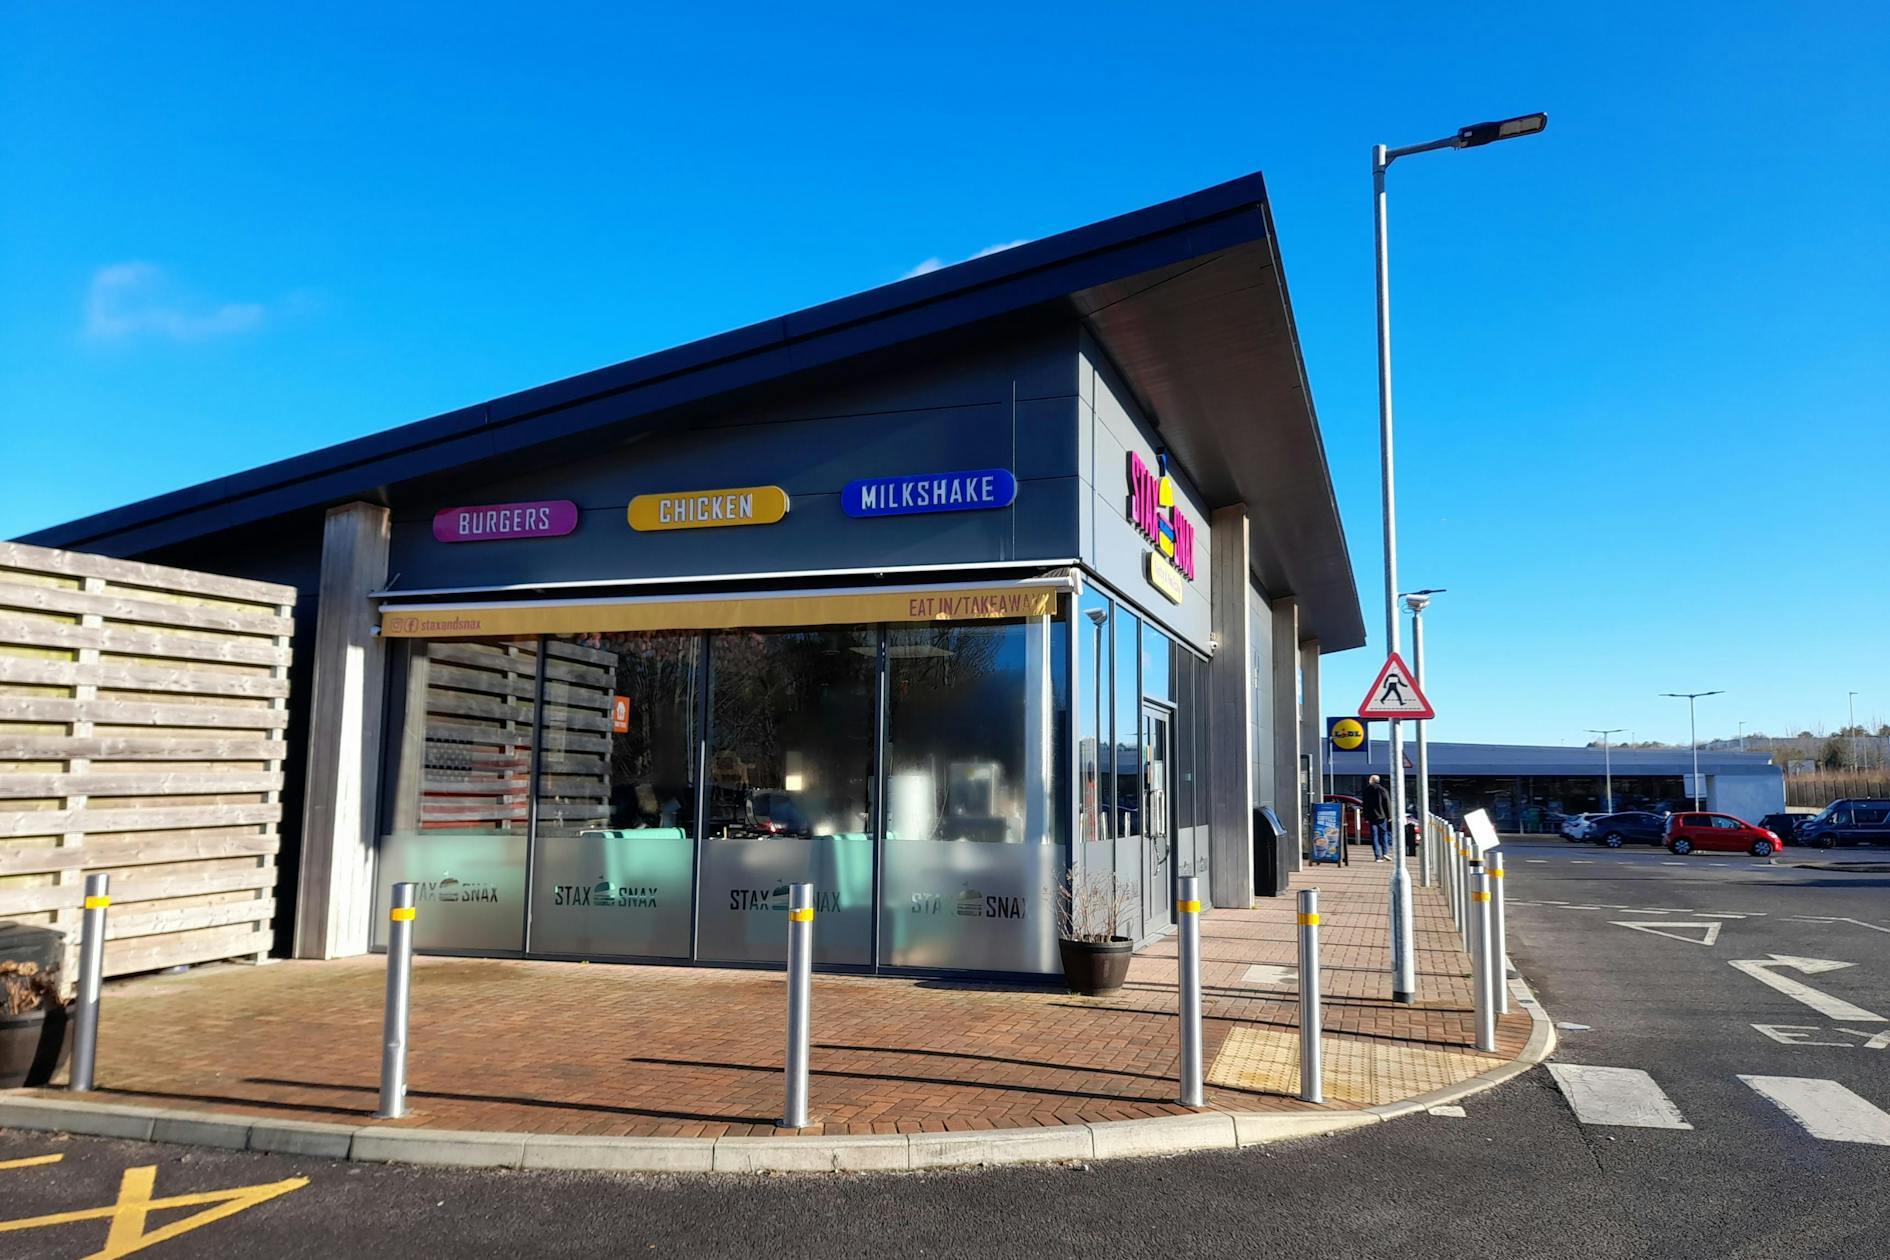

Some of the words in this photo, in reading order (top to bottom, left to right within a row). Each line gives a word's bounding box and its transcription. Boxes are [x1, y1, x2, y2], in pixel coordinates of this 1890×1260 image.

[861, 475, 994, 510] MILKSHAKE
[659, 493, 753, 524] CHICKEN
[459, 507, 550, 535] BURGERS
[909, 598, 935, 617] EAT
[412, 881, 438, 902] TAX
[555, 886, 591, 906] STAX
[618, 887, 658, 908] SNAX
[730, 889, 769, 911] STAX
[813, 891, 841, 912] NAX
[911, 892, 942, 915] STA
